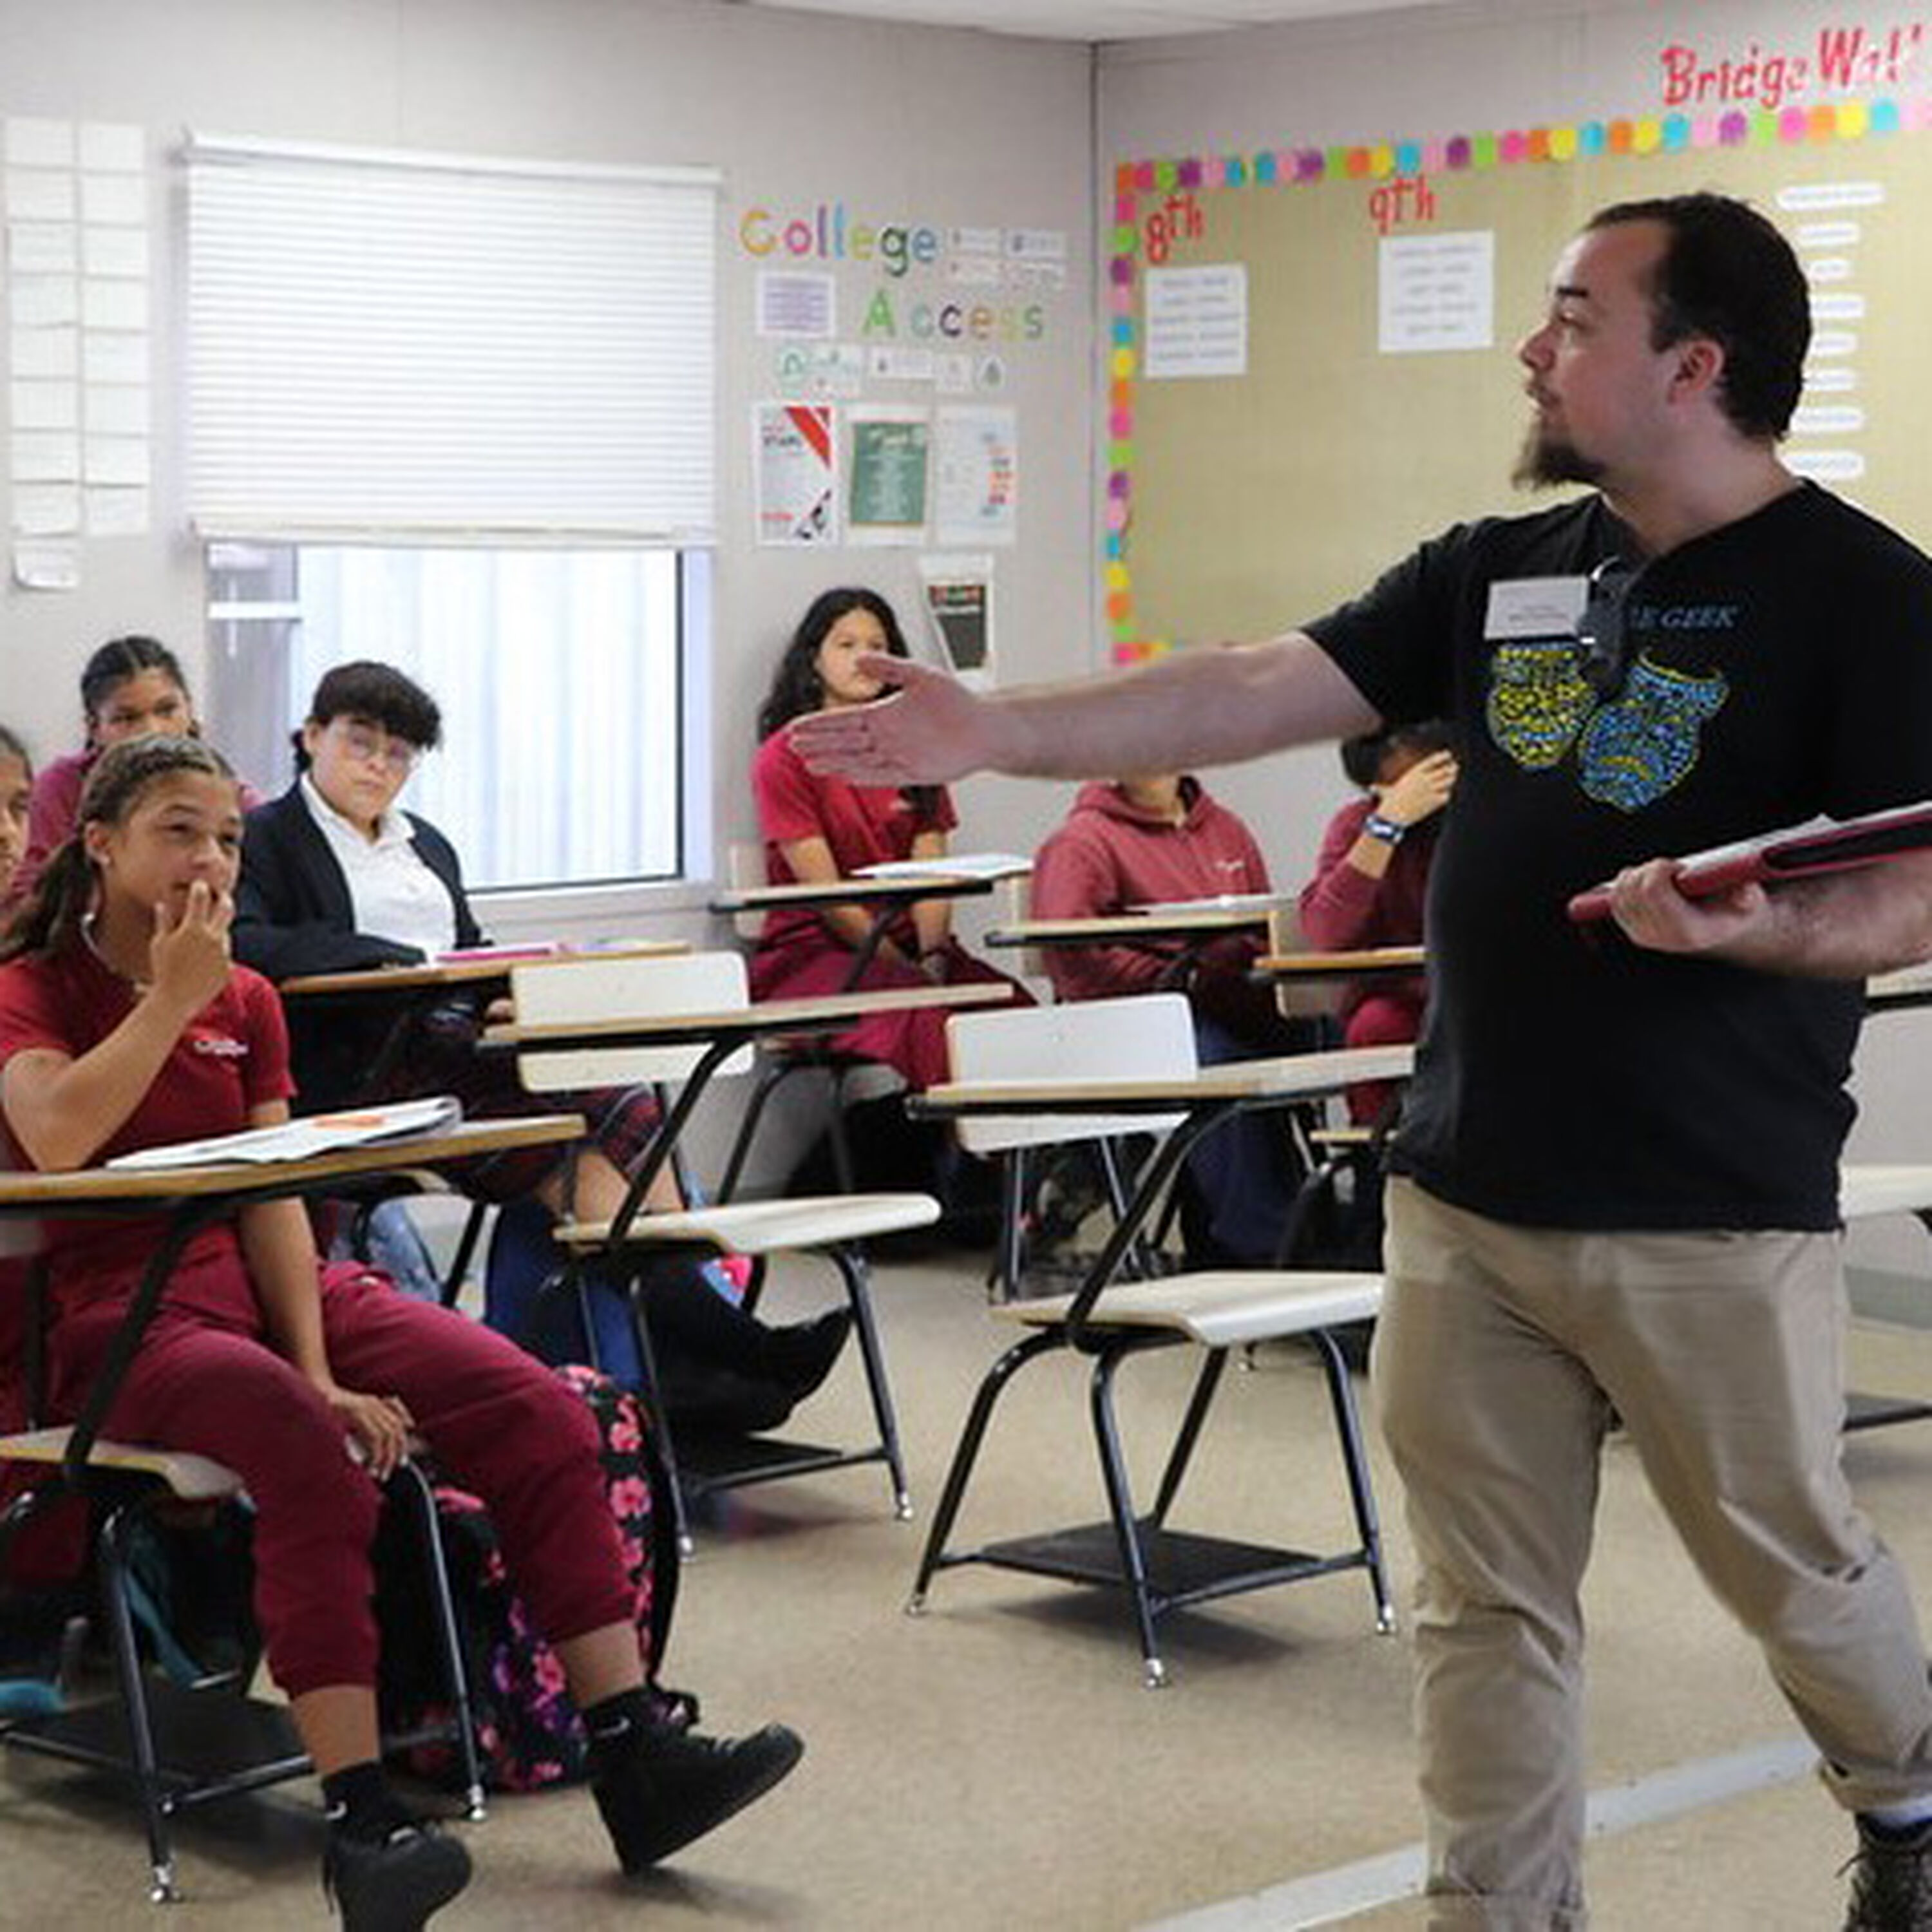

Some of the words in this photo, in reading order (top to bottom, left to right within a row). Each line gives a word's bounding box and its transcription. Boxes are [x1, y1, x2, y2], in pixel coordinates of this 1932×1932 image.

[1660, 44, 1807, 109] Bridge
[740, 203, 938, 278] College
[862, 289, 1043, 341] Access
